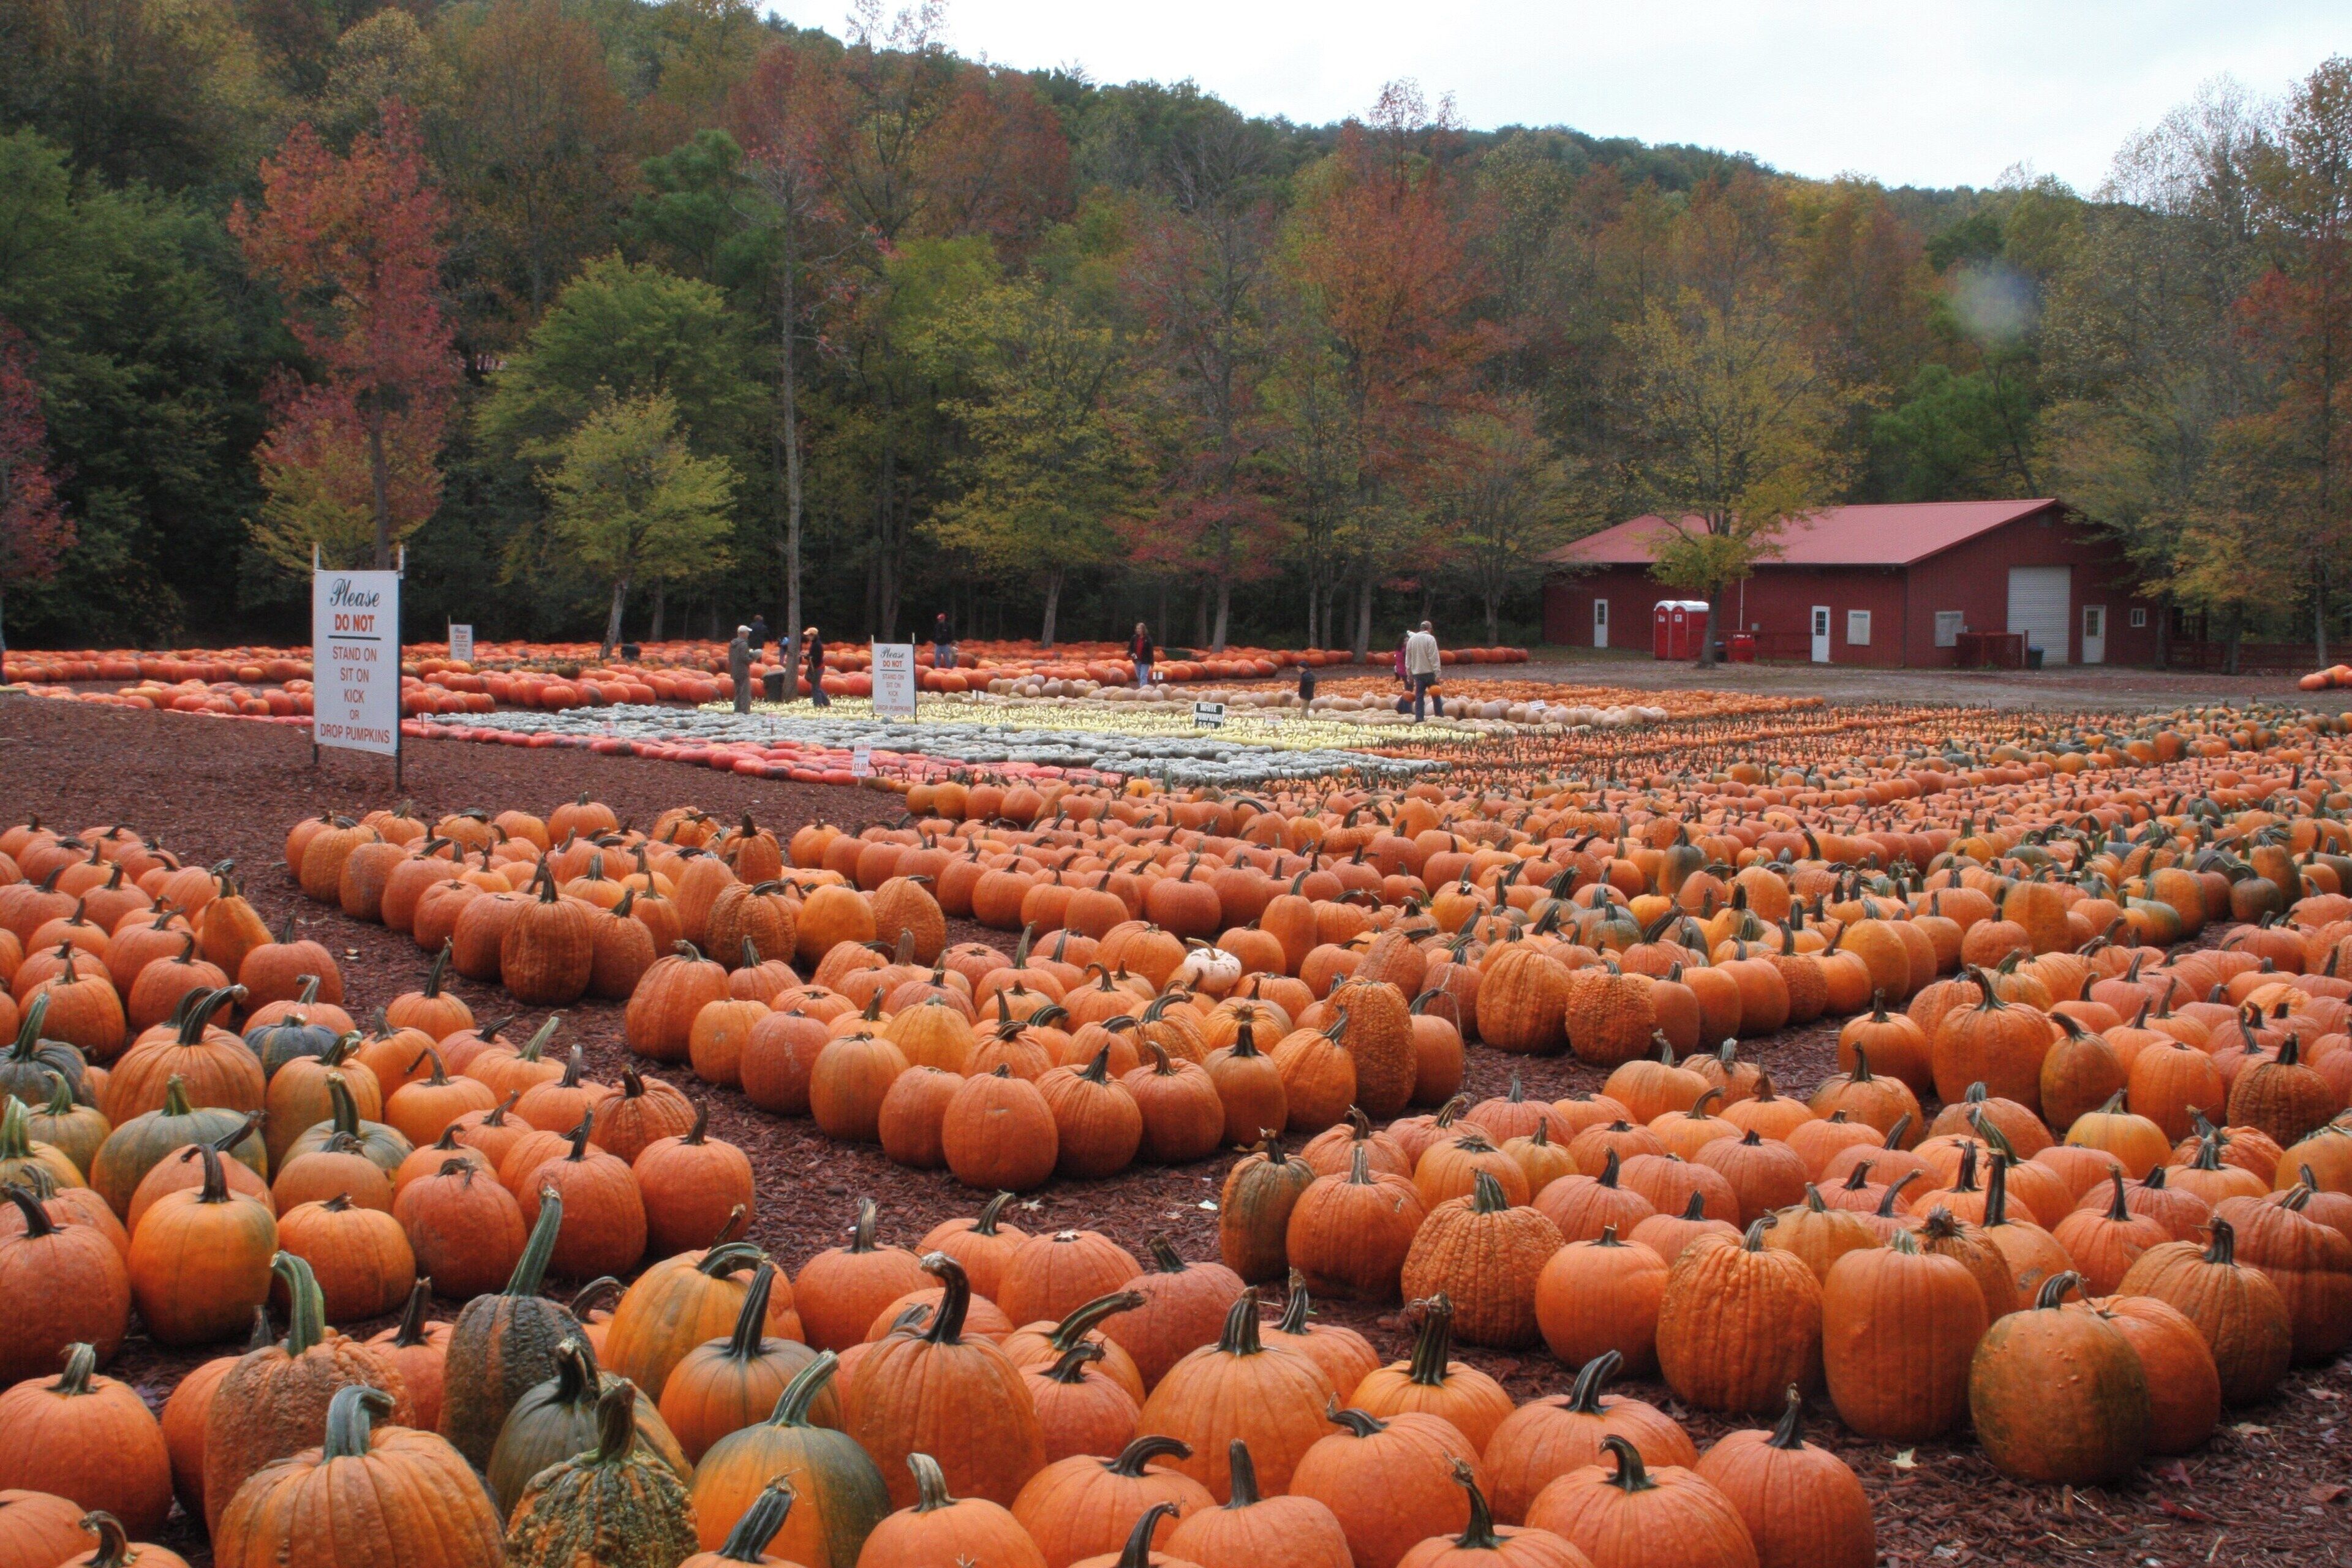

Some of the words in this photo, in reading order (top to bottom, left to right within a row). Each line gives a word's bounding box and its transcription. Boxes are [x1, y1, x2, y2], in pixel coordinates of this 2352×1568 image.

[330, 578, 380, 607] Please
[334, 614, 349, 631] DO
[353, 614, 375, 632] NOT
[333, 646, 361, 661] STAND
[364, 648, 377, 662] ON
[880, 647, 904, 658] Please
[340, 667, 353, 681] SIT
[356, 668, 369, 682] ON
[344, 688, 364, 704] KICK
[350, 709, 360, 720] OR
[1200, 704, 1216, 712] WHITE
[1195, 712, 1223, 723] PUMPKINS
[320, 723, 343, 739] DROP
[346, 726, 390, 744] PUMPKINS
